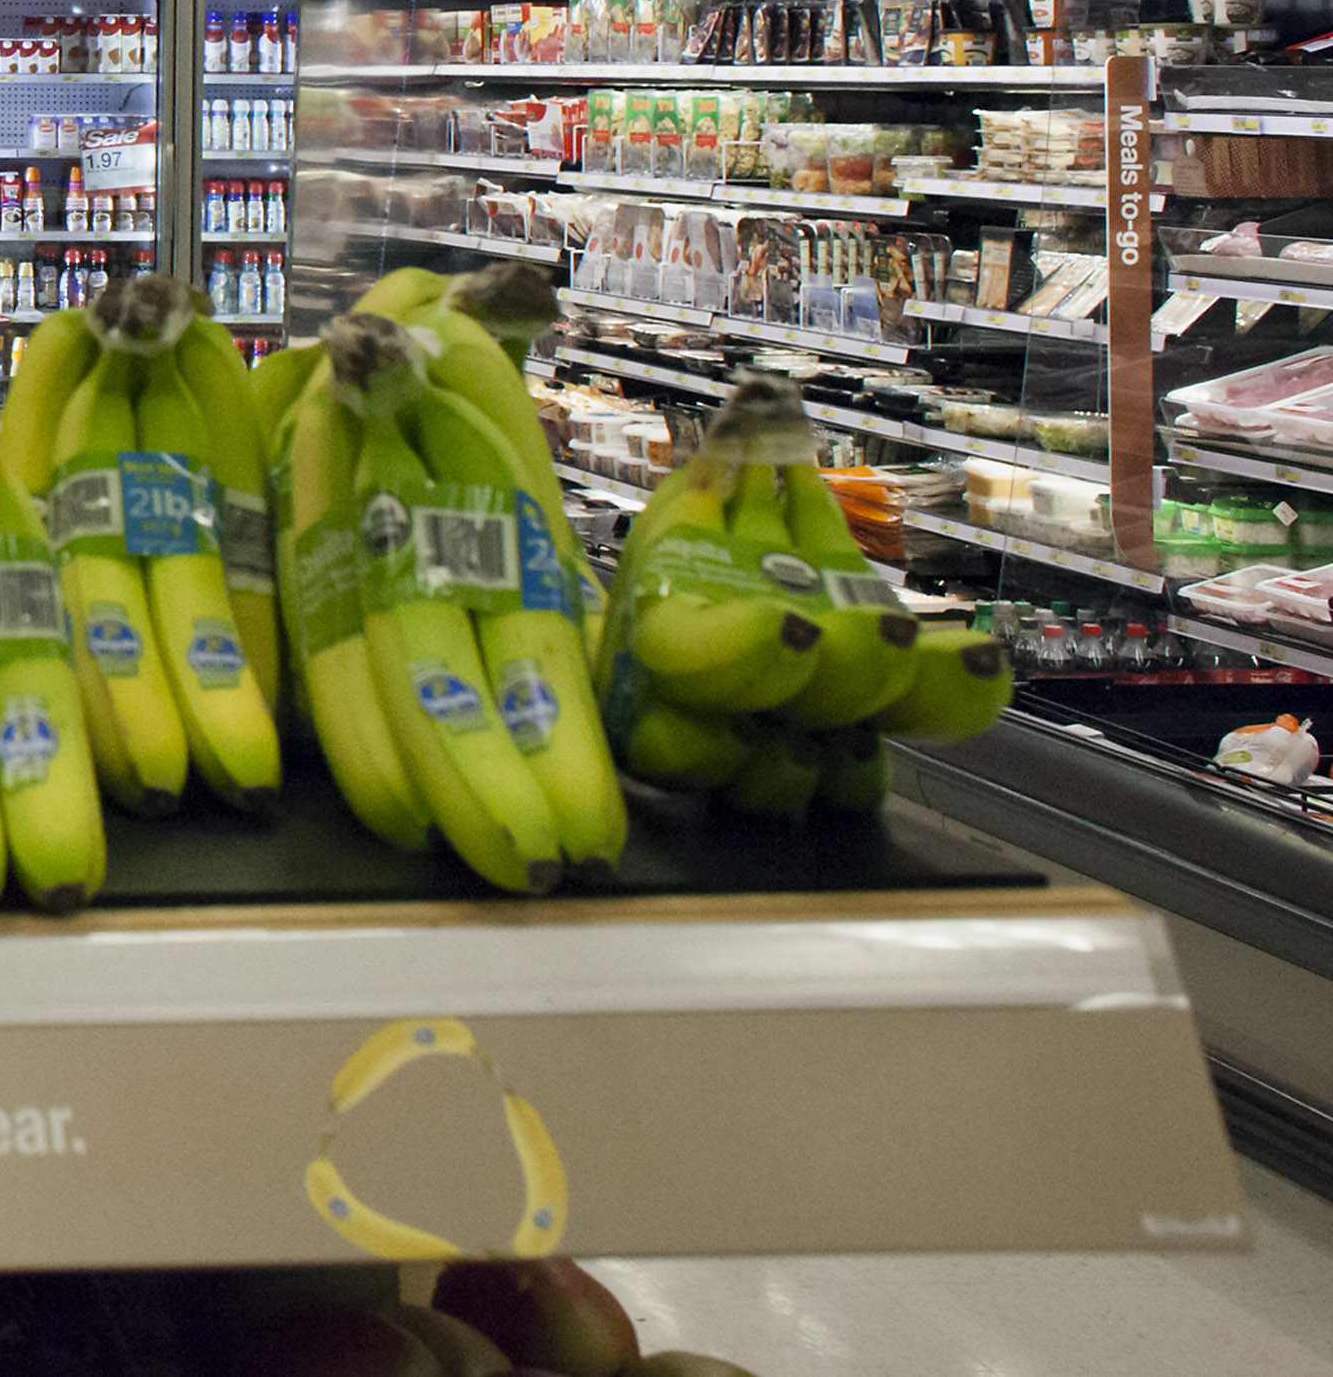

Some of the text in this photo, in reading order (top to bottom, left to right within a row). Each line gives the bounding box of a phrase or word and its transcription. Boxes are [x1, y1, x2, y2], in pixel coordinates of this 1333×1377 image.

[85, 130, 139, 148] Sale
[86, 151, 122, 169] 1.97
[1116, 105, 1142, 265] Meals to-go
[129, 487, 190, 518] 2lb
